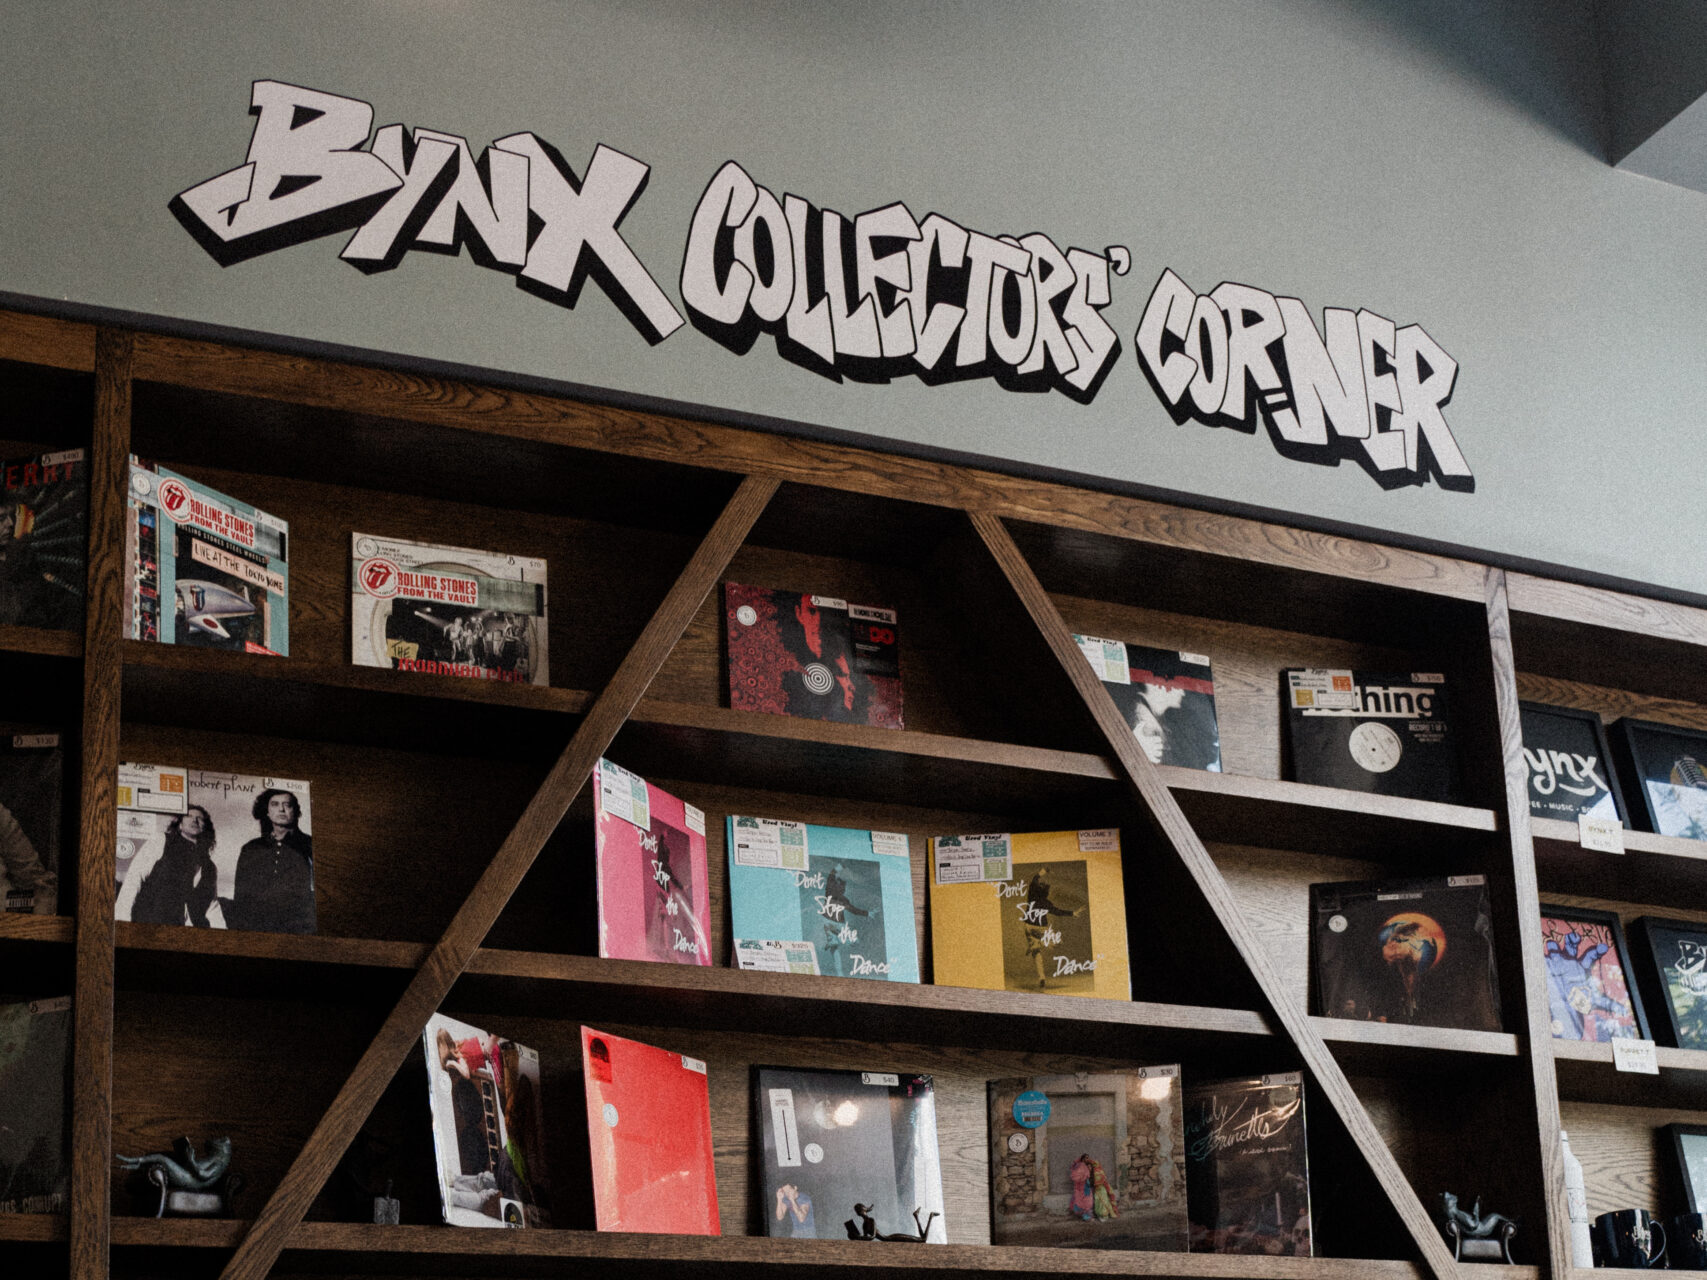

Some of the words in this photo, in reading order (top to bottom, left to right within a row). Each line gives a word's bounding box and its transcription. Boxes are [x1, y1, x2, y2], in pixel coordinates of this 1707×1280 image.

[168, 79, 686, 347] BYNX
[680, 159, 1130, 405] COLLECTORS'
[1135, 267, 1476, 494] CORNER
[0, 462, 75, 491] ERRY
[190, 498, 222, 526] ROLLING
[224, 512, 255, 538] STONES
[190, 514, 213, 532] FROM
[214, 523, 230, 538] THE
[230, 529, 254, 547] VAULT
[221, 556, 240, 573] THE
[397, 572, 438, 589] ROLLING
[440, 577, 477, 595] STONES
[397, 587, 427, 599] FROM
[428, 590, 445, 601] THE
[448, 593, 477, 605] VAULT
[391, 641, 412, 660] THE
[1548, 802, 1574, 812] MUSIC
[651, 860, 670, 892] Stop
[666, 893, 679, 916] the
[814, 896, 846, 921] Stop
[1016, 902, 1049, 925] Stop
[838, 922, 858, 943] the
[1041, 924, 1061, 947] the
